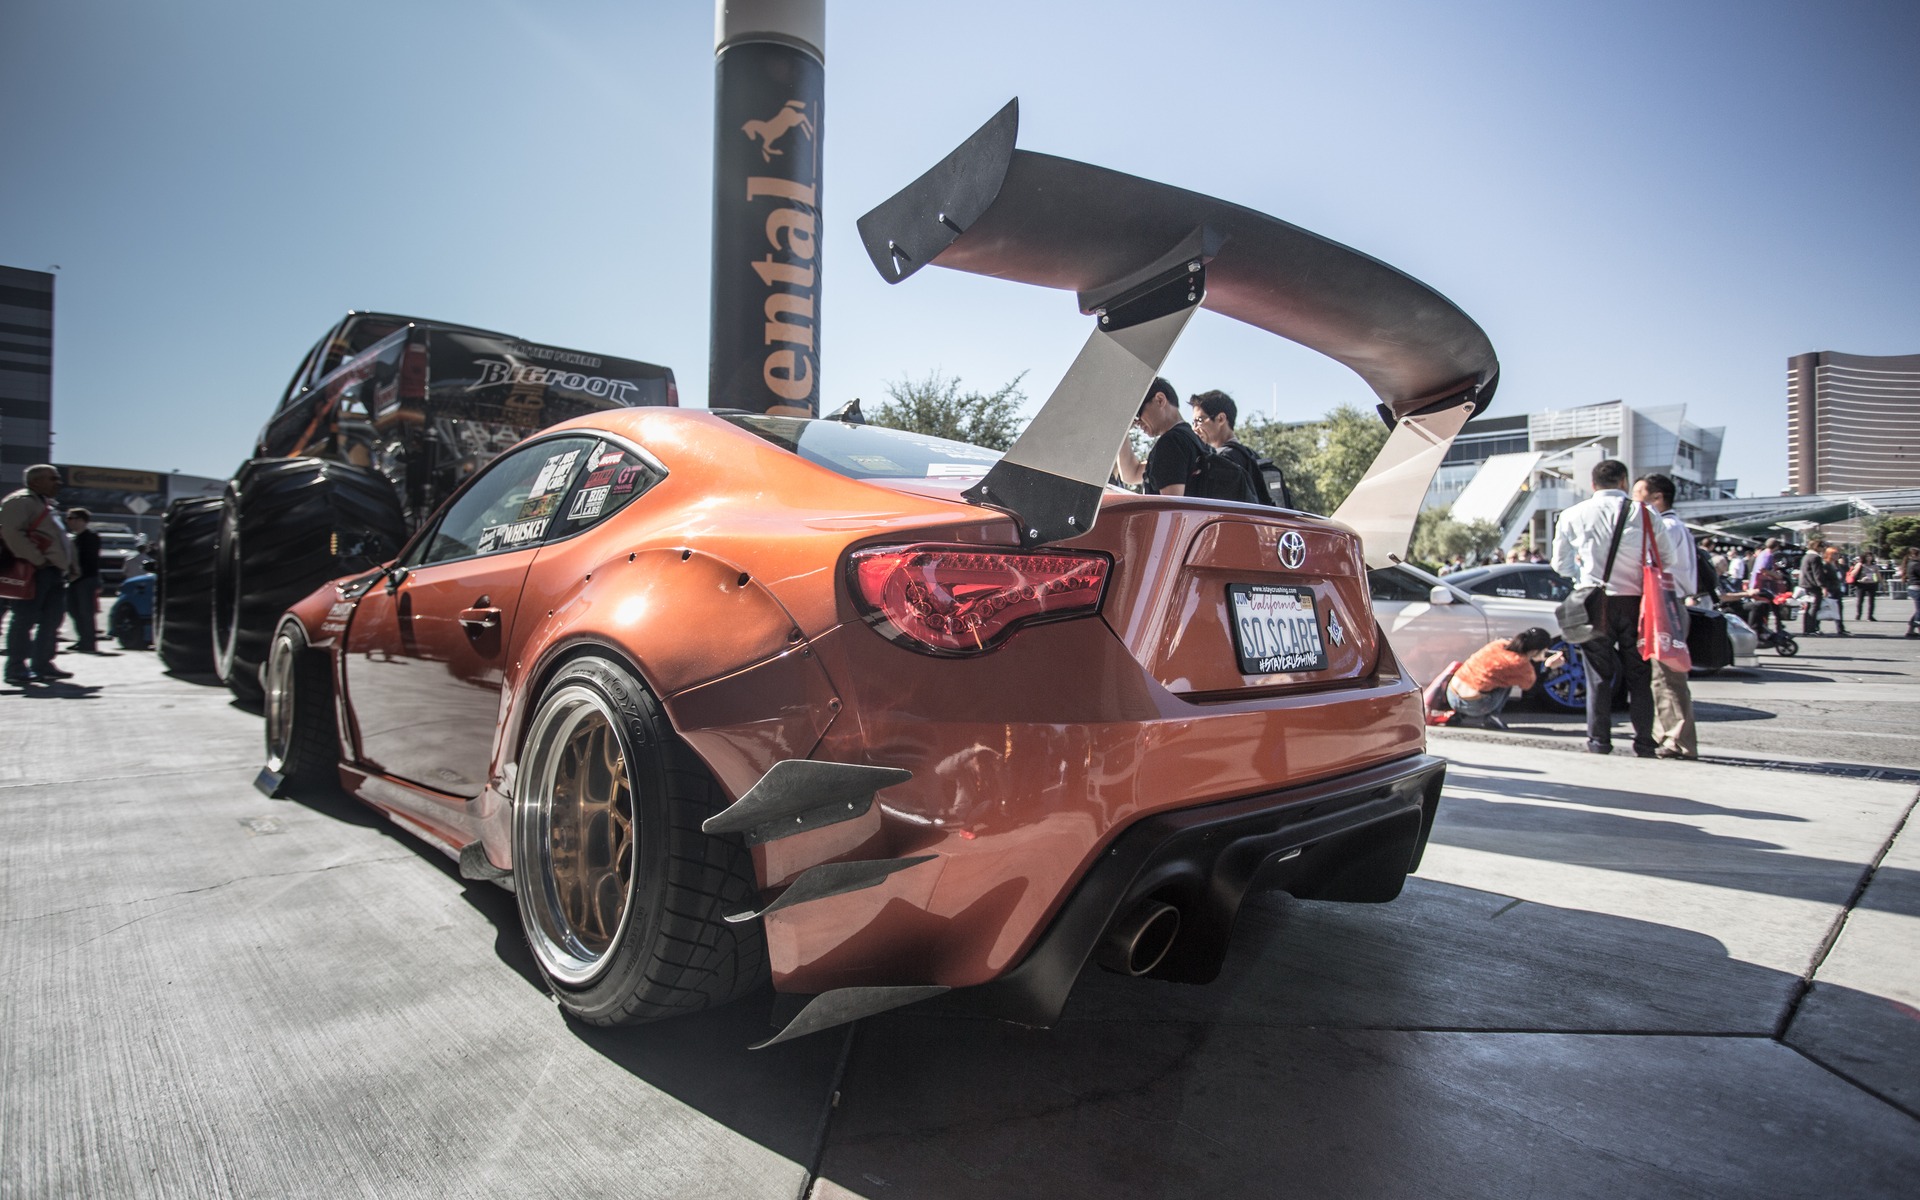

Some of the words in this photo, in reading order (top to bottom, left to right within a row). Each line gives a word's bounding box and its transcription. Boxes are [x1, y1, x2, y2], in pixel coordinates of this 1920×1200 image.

[553, 350, 601, 369] POWERED
[465, 358, 639, 408] BIGFOOT
[589, 488, 608, 503] BIG
[582, 505, 601, 516] LABS
[503, 517, 550, 544] WHISKEY
[1250, 593, 1303, 616] California
[601, 668, 646, 744] TOYO
